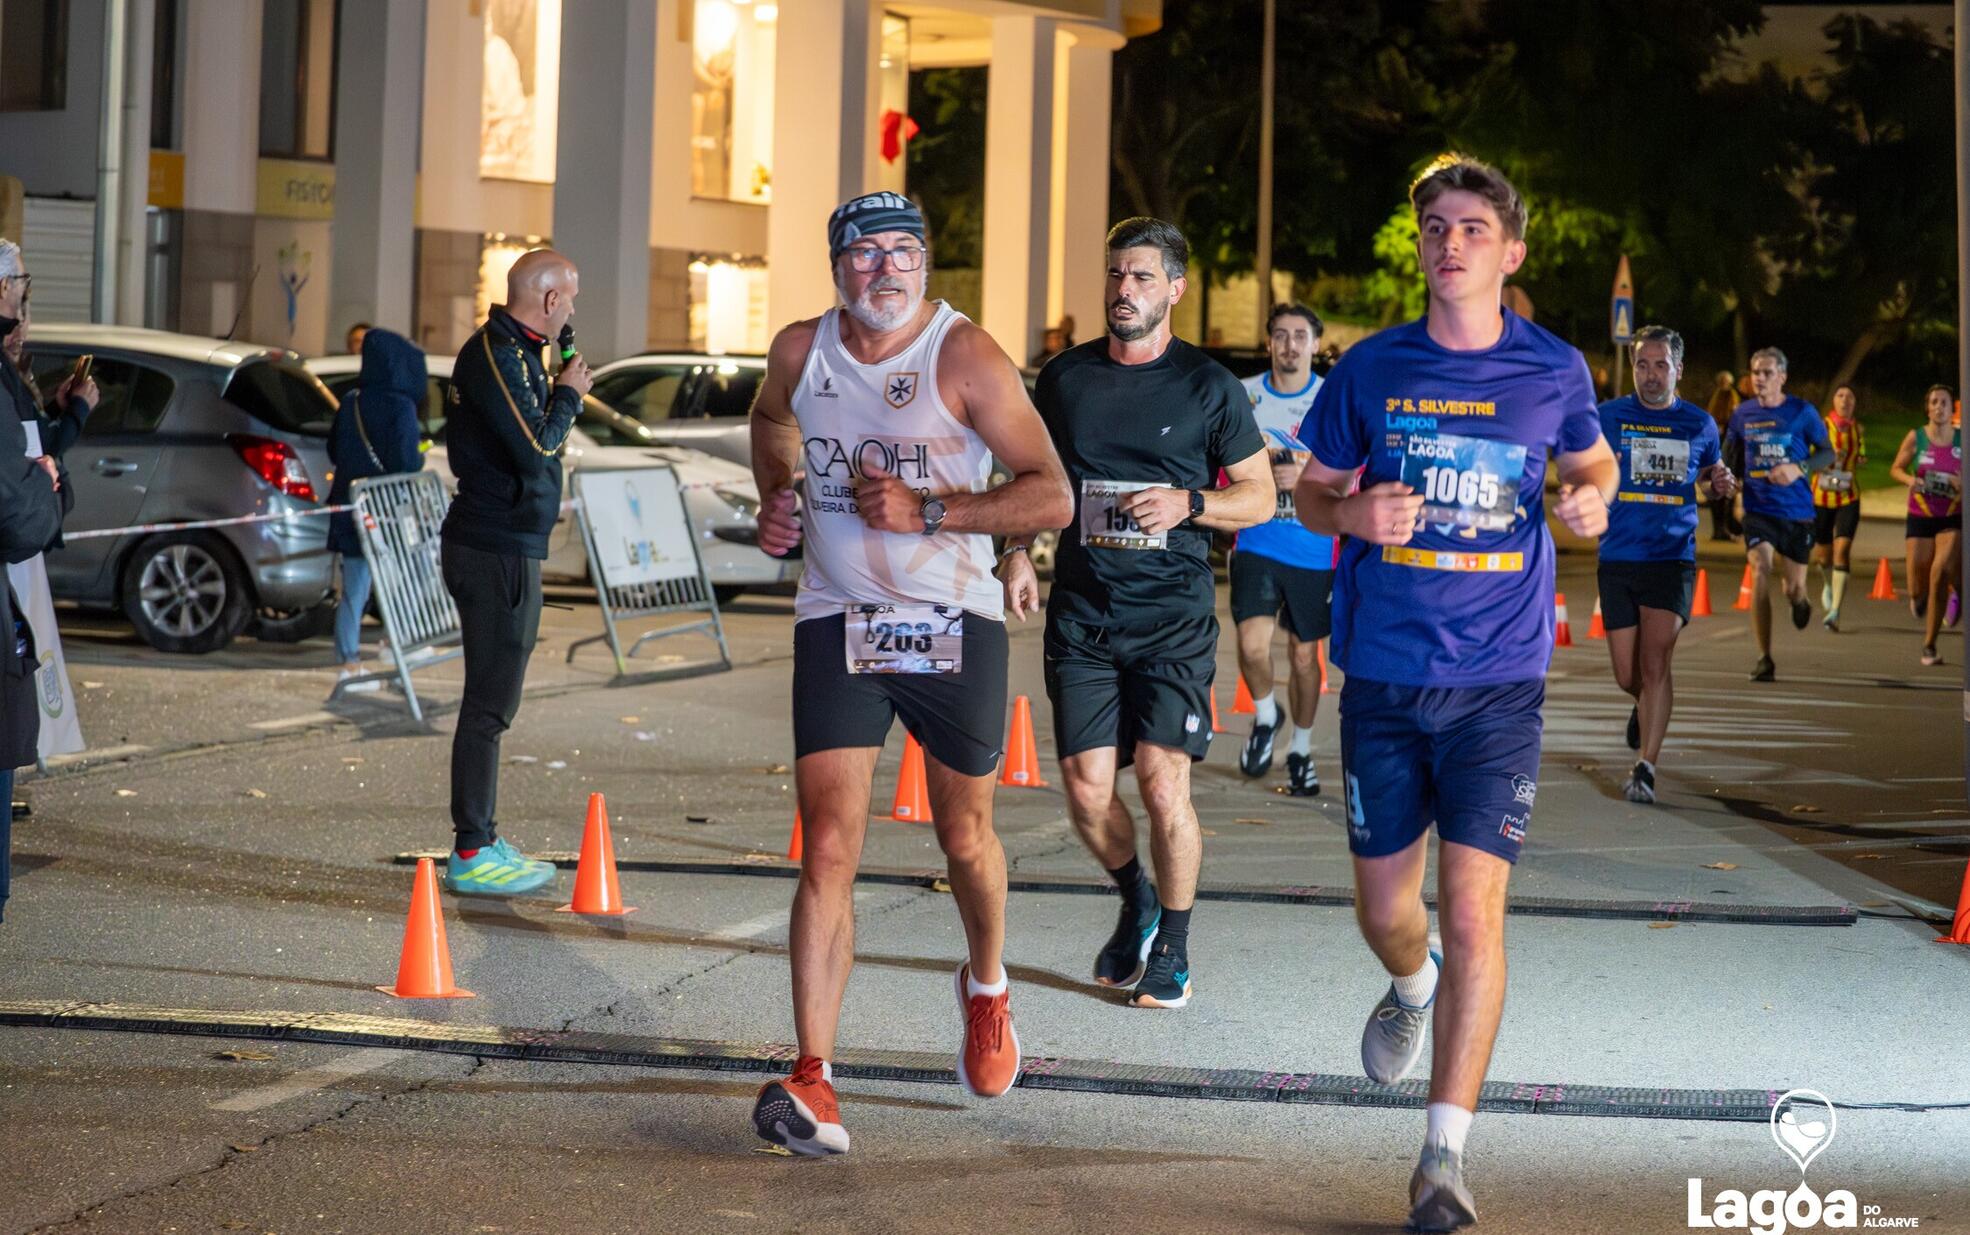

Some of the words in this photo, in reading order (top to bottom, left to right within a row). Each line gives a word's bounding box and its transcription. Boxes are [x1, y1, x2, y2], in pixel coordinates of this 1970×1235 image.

[1403, 399, 1417, 413] S.
[1419, 400, 1496, 416] SILVESTRE
[1386, 413, 1438, 432] Lagoa
[1408, 442, 1456, 461] LAGOA
[1647, 453, 1675, 471] 441
[1422, 465, 1499, 510] 1065
[875, 622, 932, 654] 203
